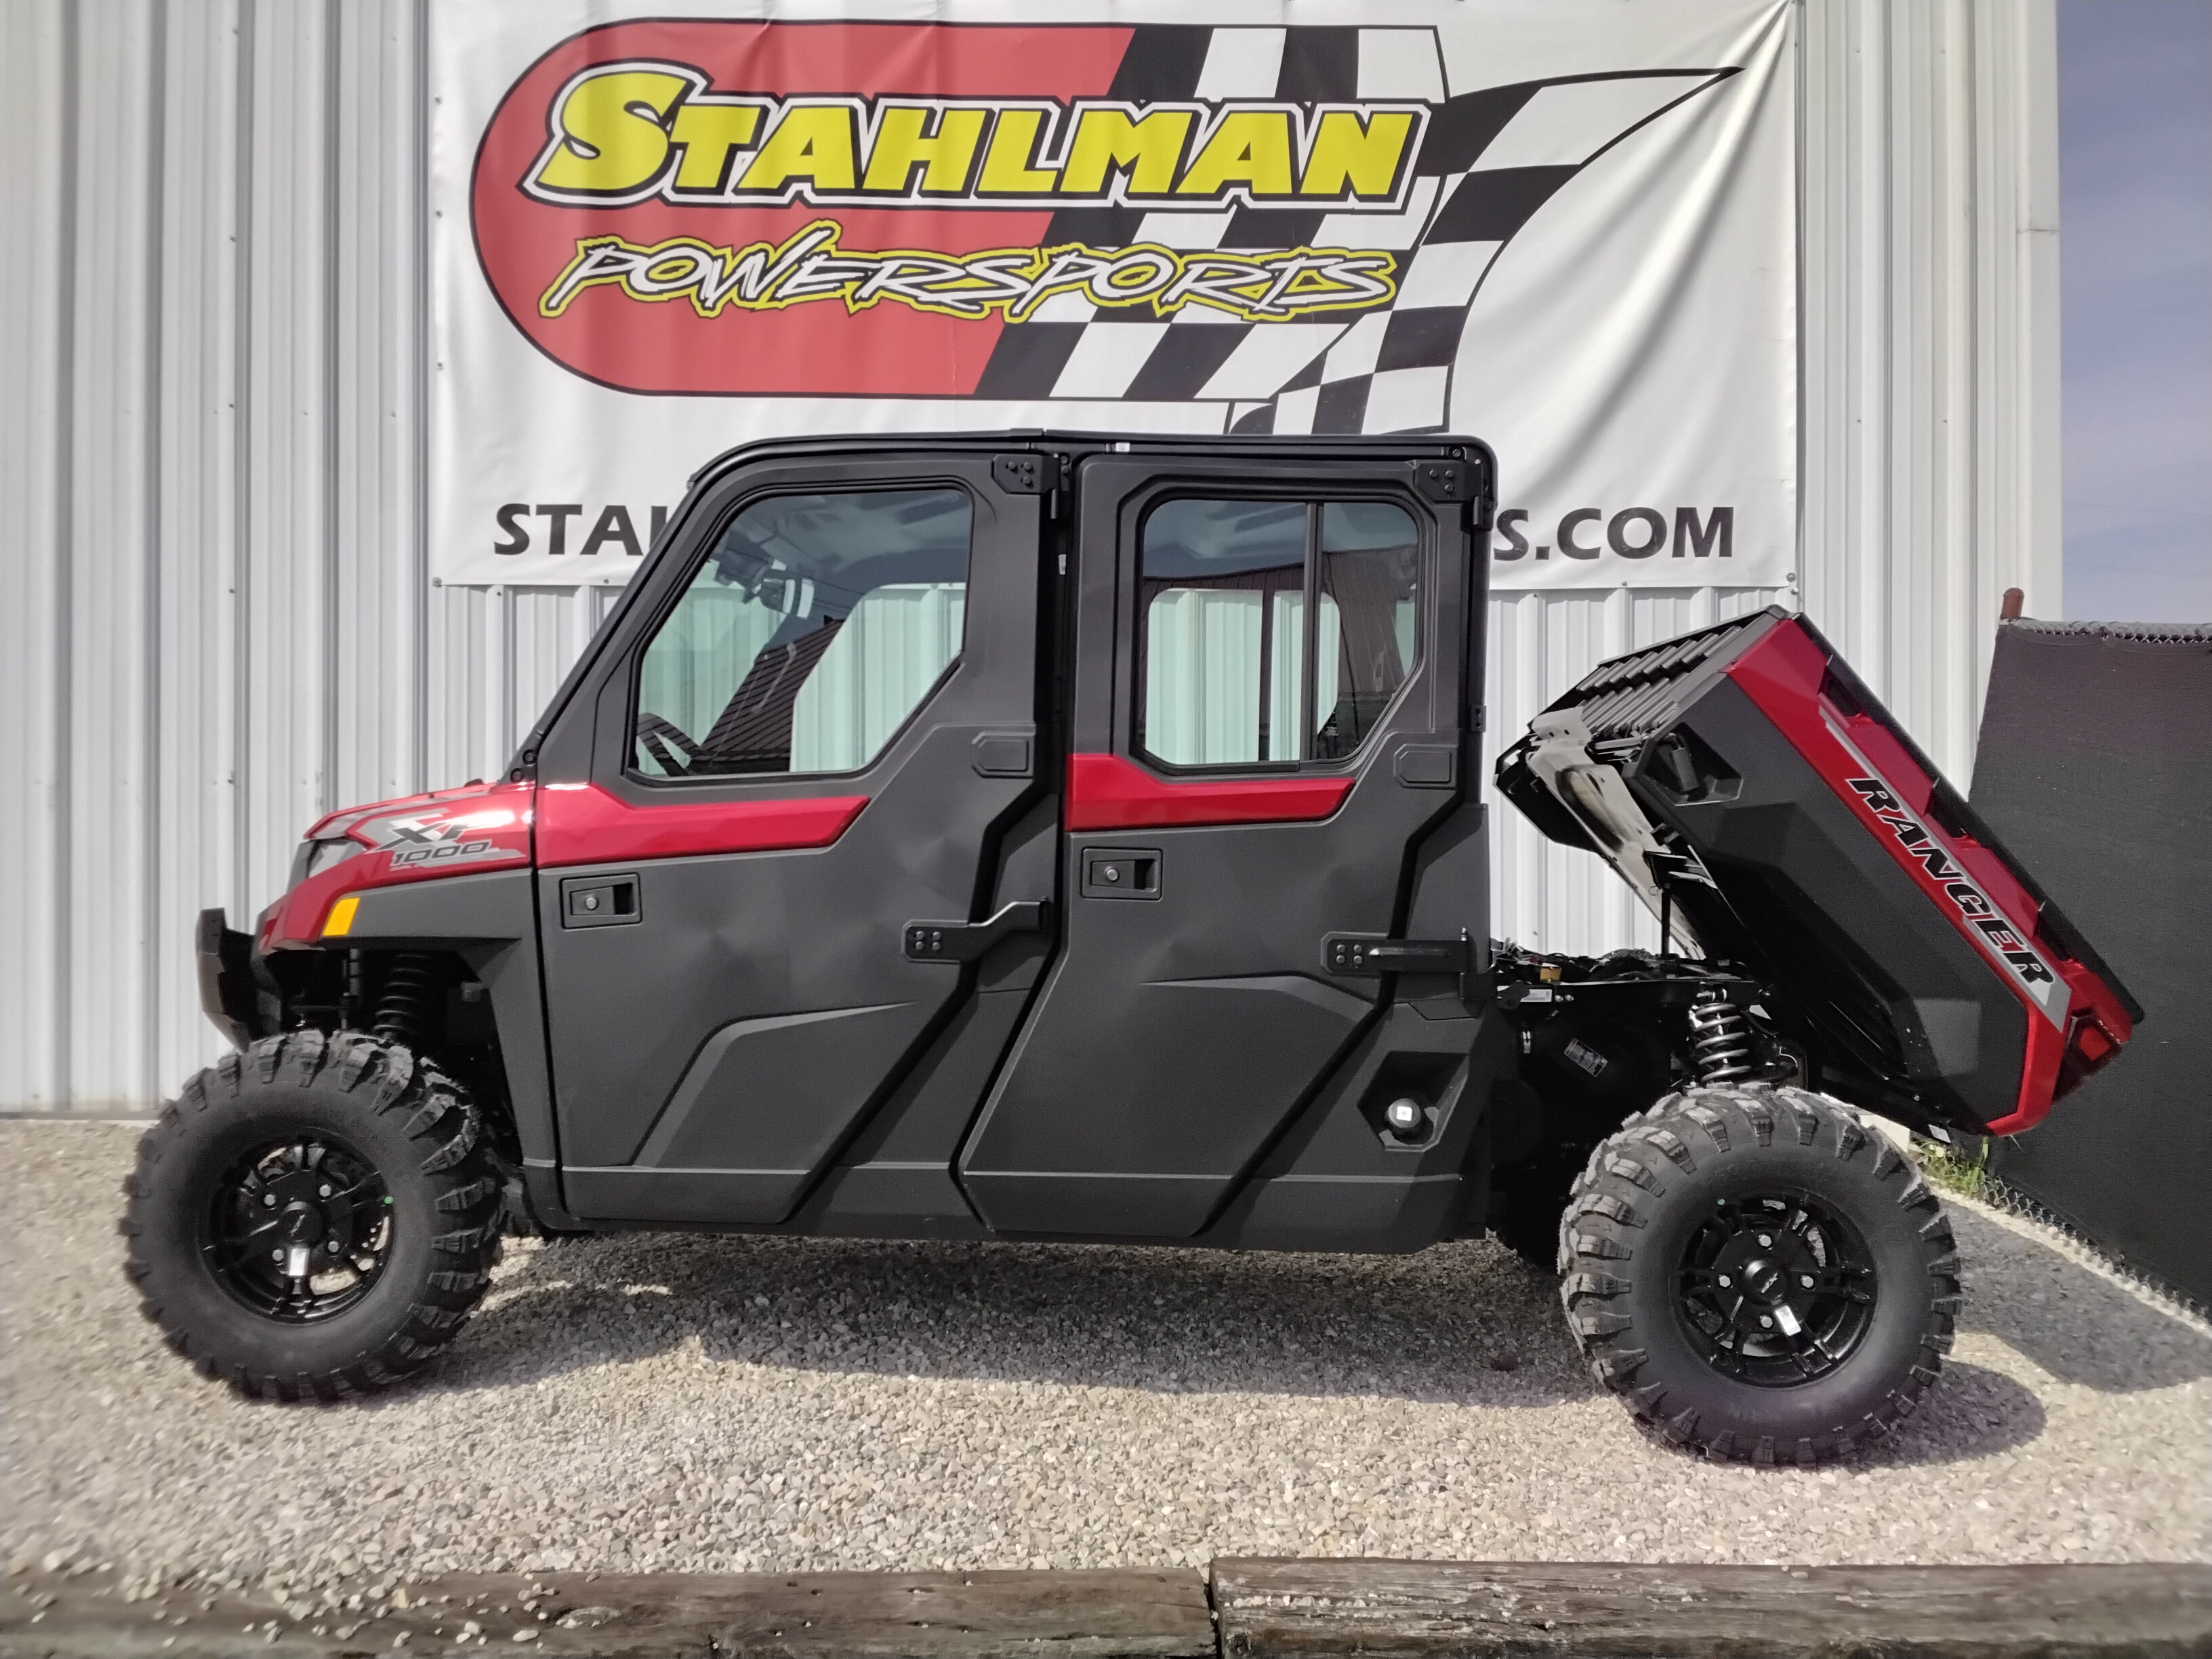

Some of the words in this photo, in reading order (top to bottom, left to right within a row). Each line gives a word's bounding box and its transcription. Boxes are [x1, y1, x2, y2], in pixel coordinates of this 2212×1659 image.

[525, 64, 1425, 206] STAHLMAN
[542, 222, 1395, 319] POWERSPORTS
[391, 840, 491, 865] 1000
[1845, 777, 2054, 985] RANGER
